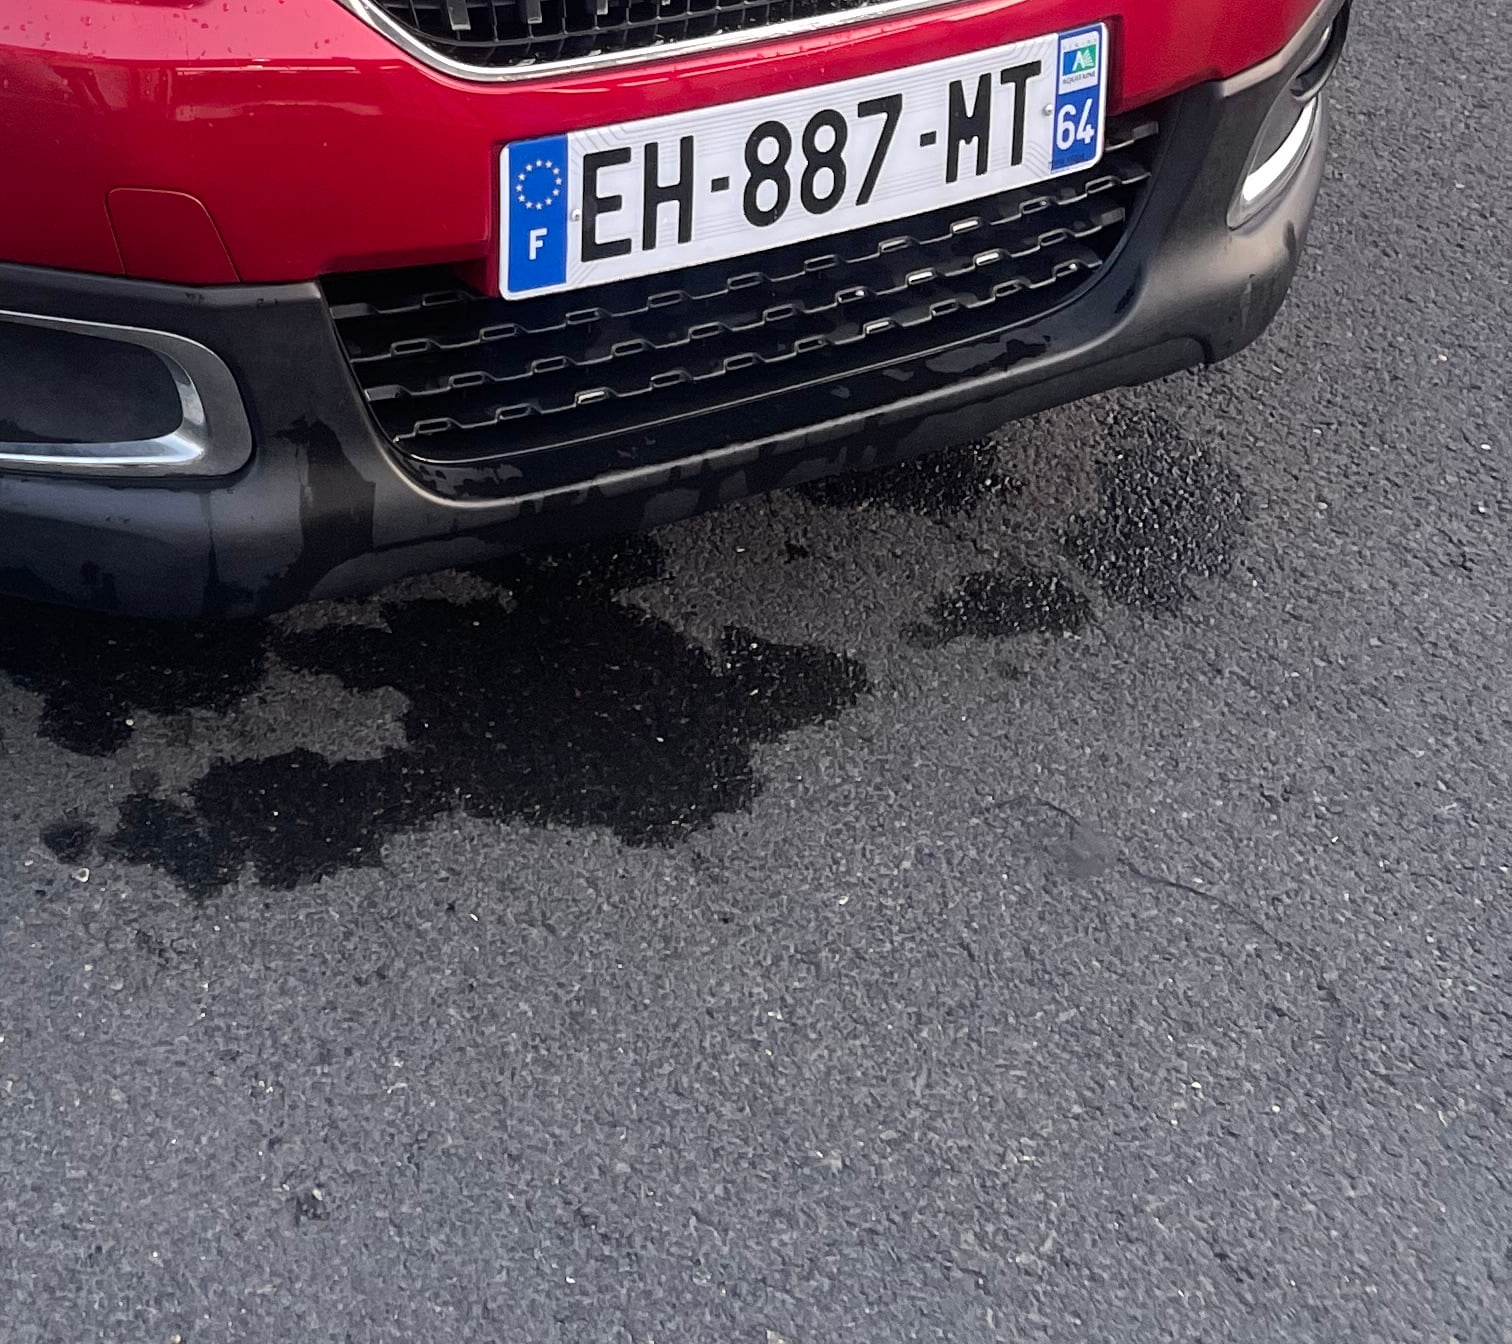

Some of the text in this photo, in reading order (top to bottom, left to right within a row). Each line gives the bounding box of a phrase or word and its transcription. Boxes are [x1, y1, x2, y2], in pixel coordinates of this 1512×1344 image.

[1055, 98, 1096, 151] 64
[580, 59, 1043, 263] EH-887-MT
[528, 227, 548, 260] F
